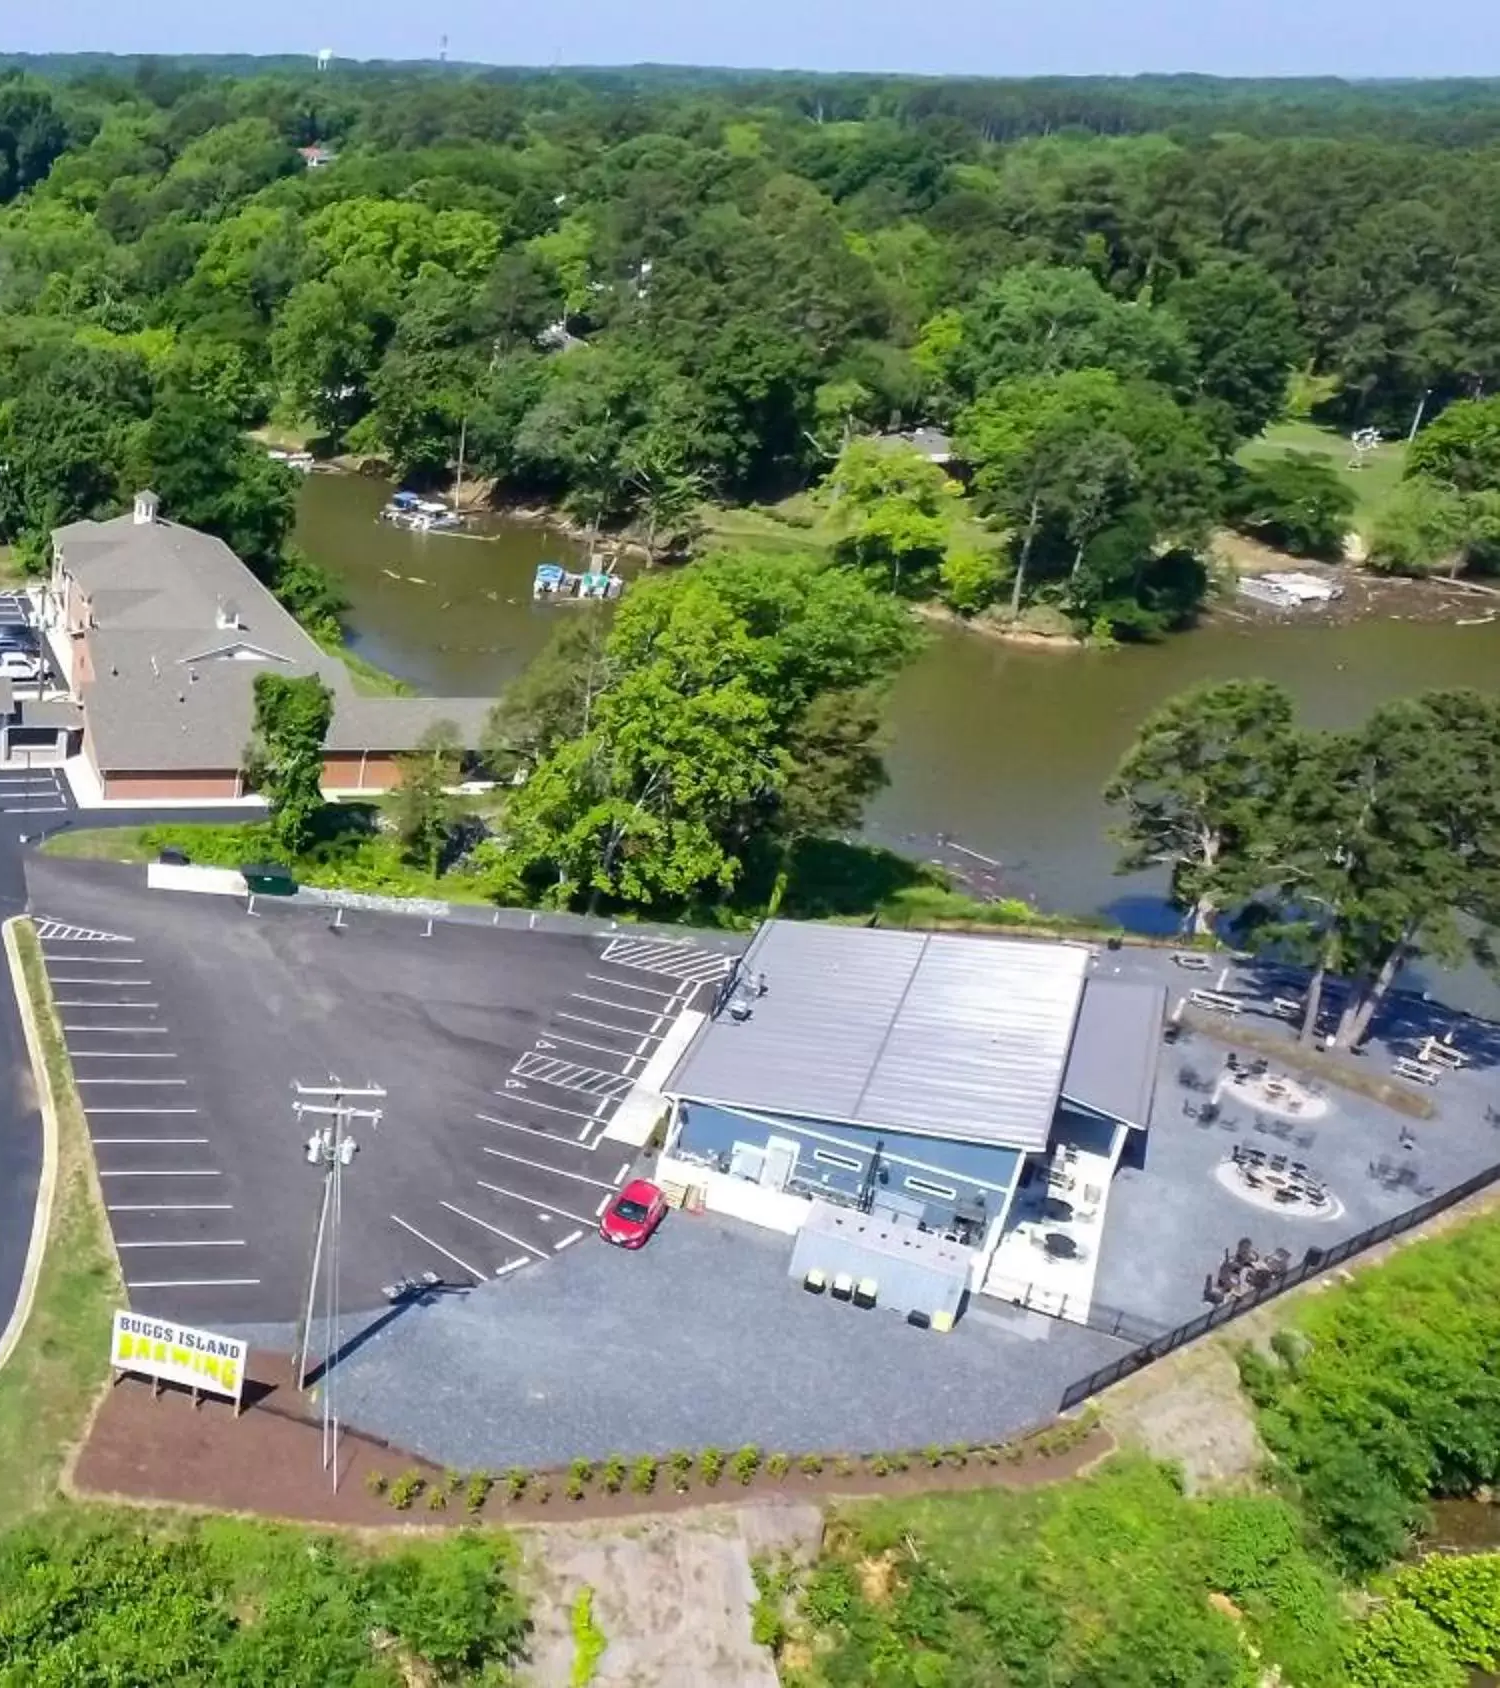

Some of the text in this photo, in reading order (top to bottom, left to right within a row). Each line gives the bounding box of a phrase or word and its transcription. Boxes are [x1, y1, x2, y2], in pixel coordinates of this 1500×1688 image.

[118, 1333, 238, 1391] BREWING
[119, 1317, 241, 1359] BUGGS ISLAND
